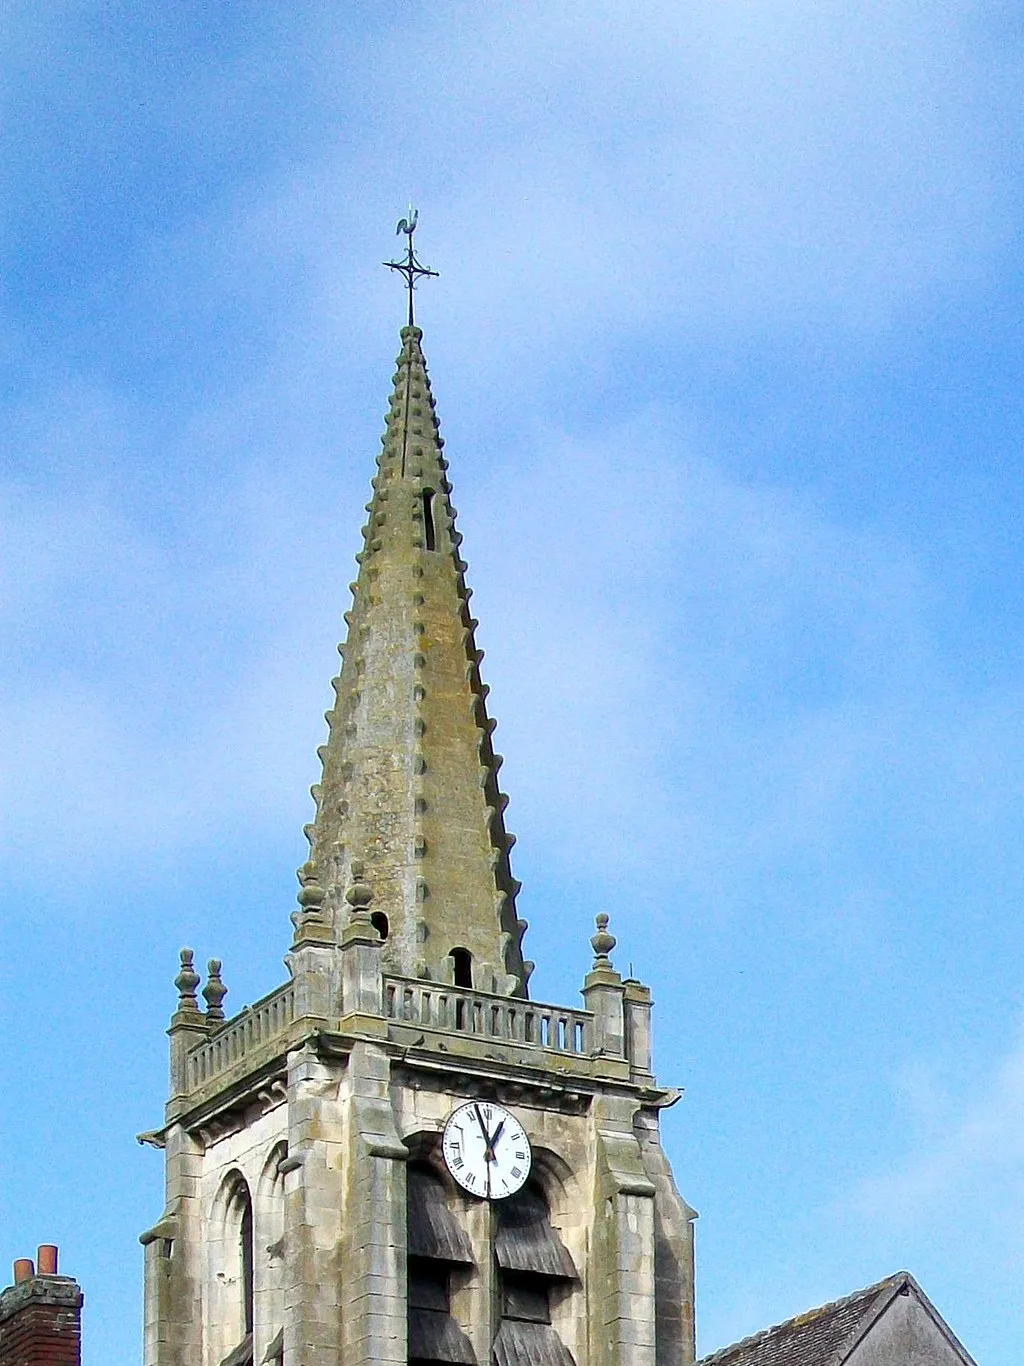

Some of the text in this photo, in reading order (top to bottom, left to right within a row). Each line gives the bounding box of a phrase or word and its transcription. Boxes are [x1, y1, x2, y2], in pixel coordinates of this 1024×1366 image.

[483, 1108, 492, 1120] XII
[511, 1133, 520, 1141] II
[515, 1151, 525, 1160] III
